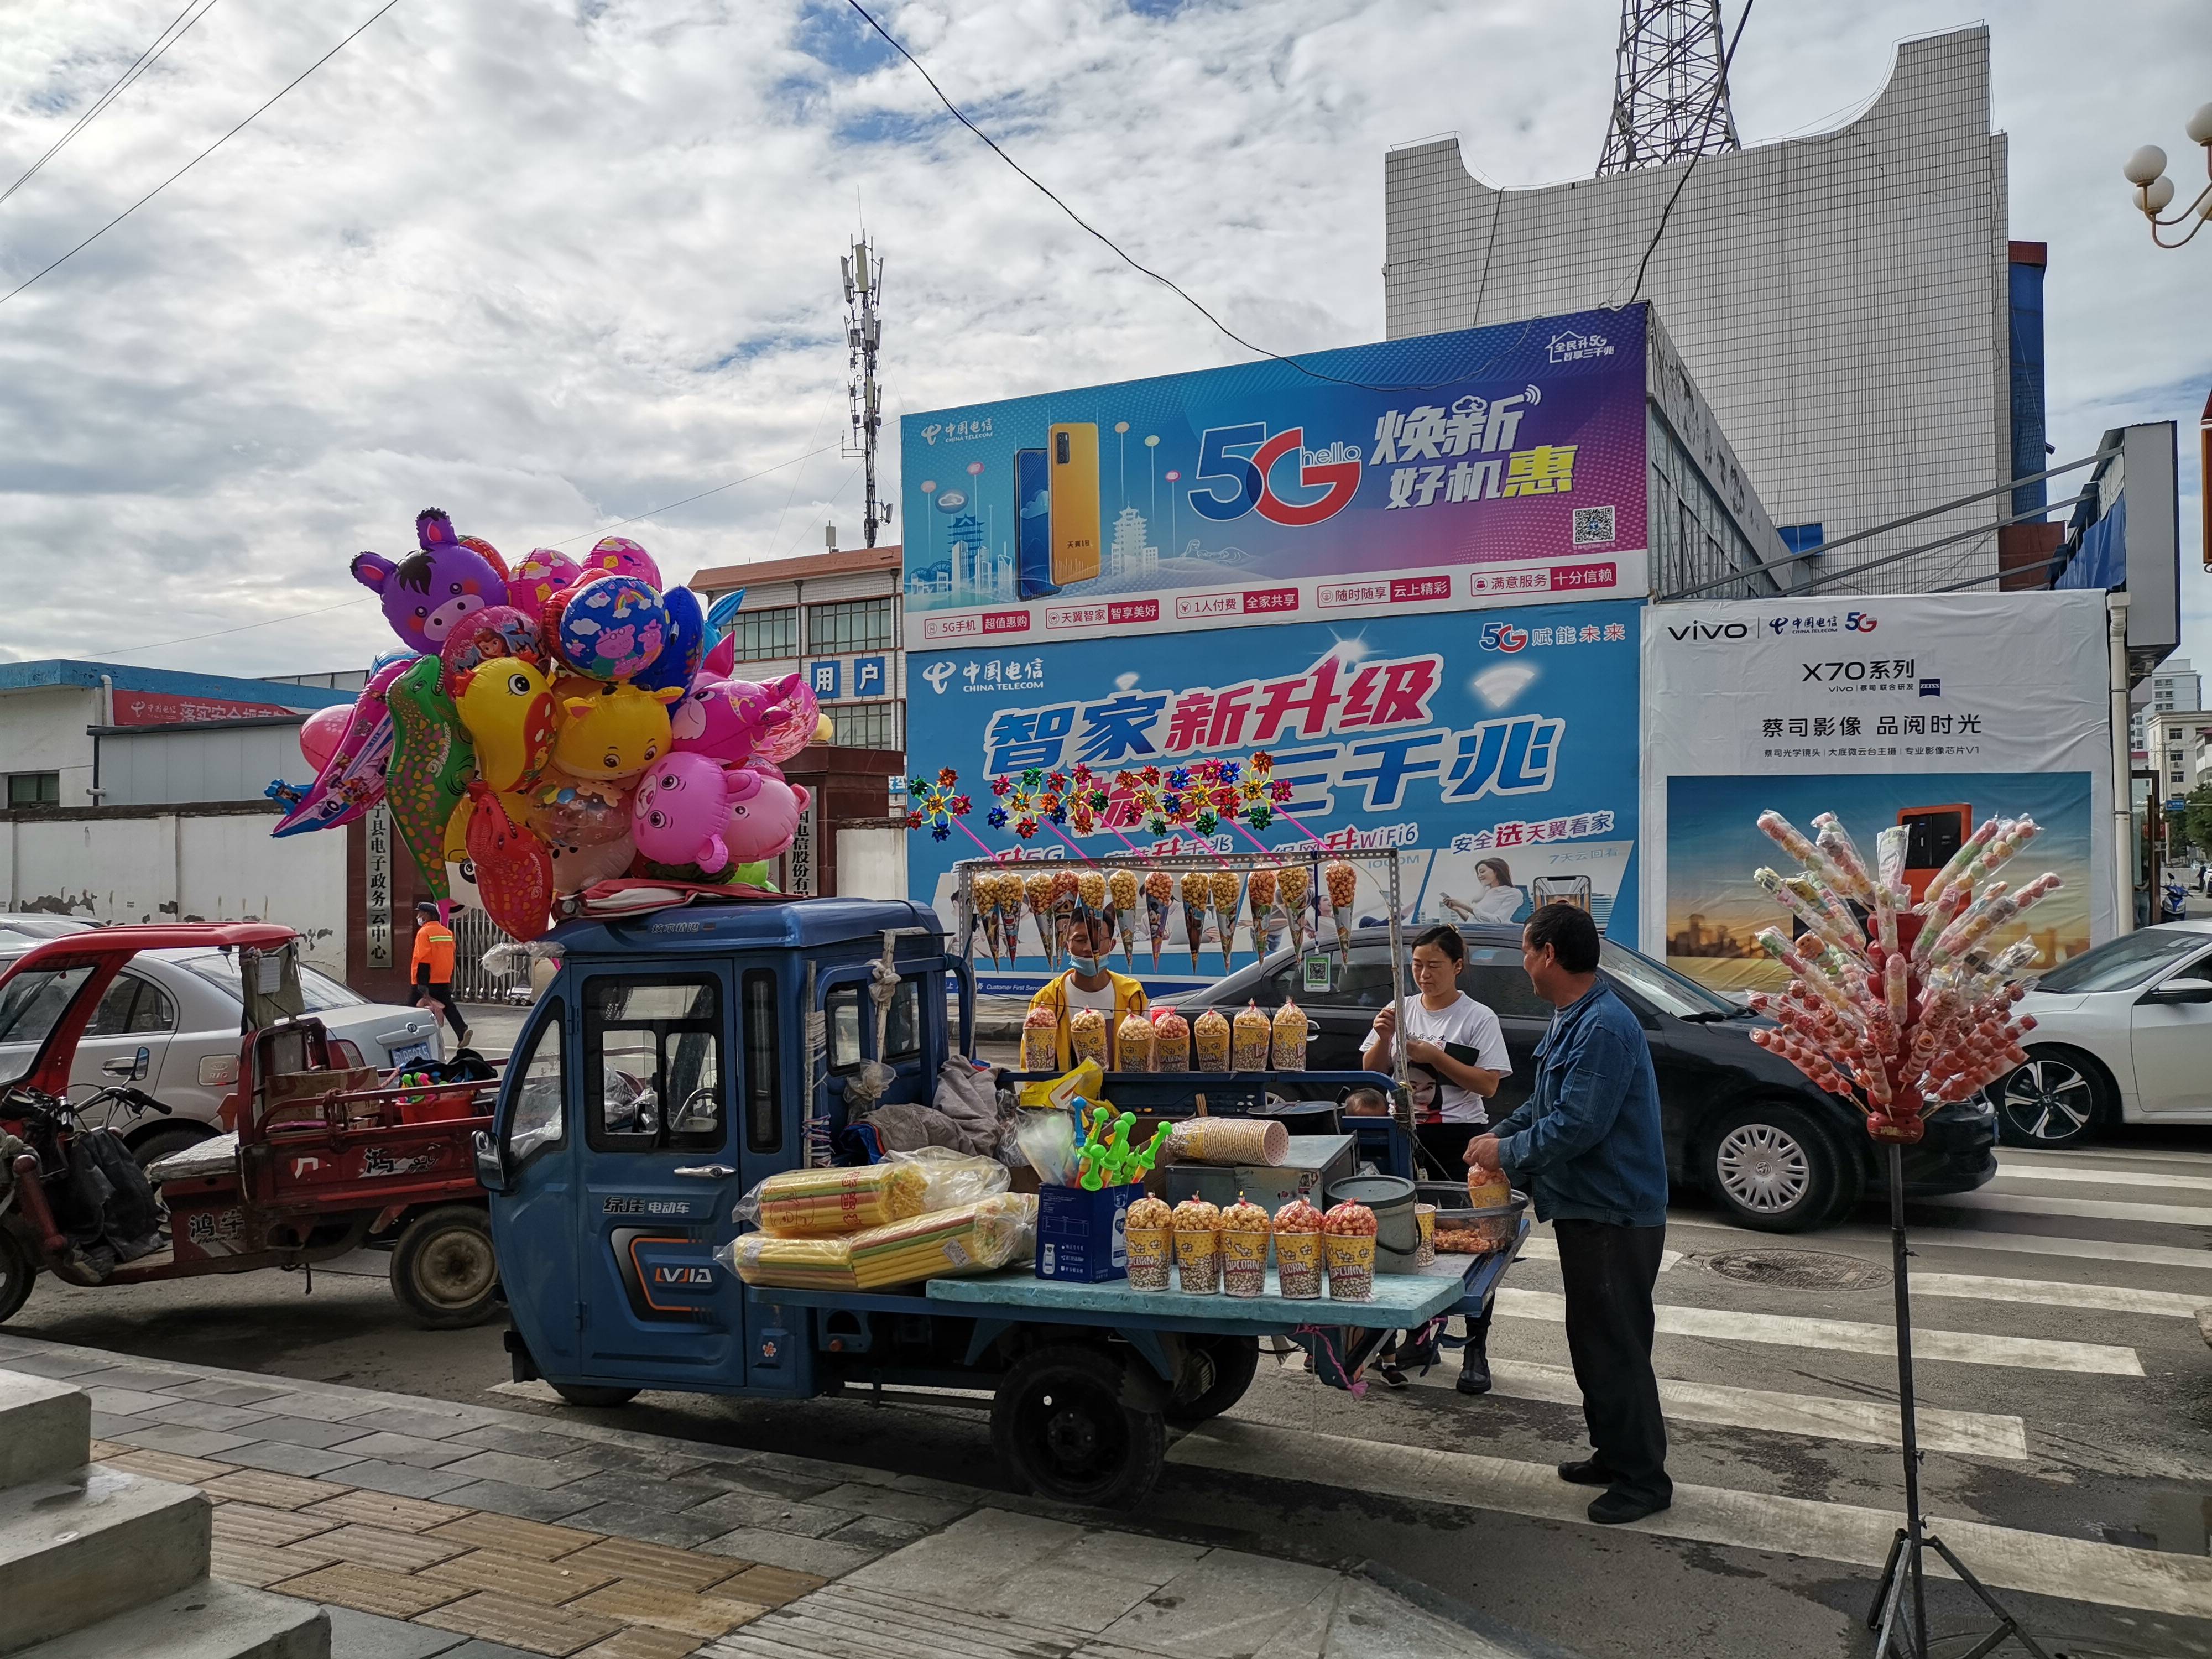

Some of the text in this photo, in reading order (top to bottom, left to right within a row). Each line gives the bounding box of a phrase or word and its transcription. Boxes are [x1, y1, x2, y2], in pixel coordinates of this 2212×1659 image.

[1554, 335, 1607, 353] 全民升5G
[945, 418, 993, 437] 中国电信
[965, 432, 993, 440] TELECOM
[1369, 394, 1525, 466] 焕新
[1302, 442, 1362, 466] hello
[1188, 421, 1363, 526] 5G
[1385, 444, 1579, 510] 好机惠
[1491, 568, 1613, 590] 满意服务 十分信赖
[1335, 581, 1448, 602] 随时随享 云上精彩
[1061, 604, 1157, 623] 天翼智家 智享美好
[1194, 594, 1296, 613] 1人付费 全家共享
[942, 615, 1027, 633] 5G手机 超值惠购
[1668, 620, 1748, 640] vivo
[1792, 616, 1838, 629] 中国电信
[1844, 611, 1877, 633] 5G
[1479, 622, 1528, 653] 5G
[1531, 623, 1626, 646] 赋能未来
[963, 658, 1044, 685] 中国电信
[1802, 659, 1914, 681] X70系列
[963, 681, 1044, 692] CHINA TELECOM
[1880, 683, 1914, 691] 联合研发
[989, 655, 1437, 775] 智家新升级
[1762, 713, 1982, 737] 蔡司影像 品阅时光
[1764, 746, 1980, 757] 蔡司光学镜头 大底微云台主摄 专业影像芯片V1
[1453, 814, 1611, 854] 安全选天翼看家
[648, 1201, 691, 1214] 电动车
